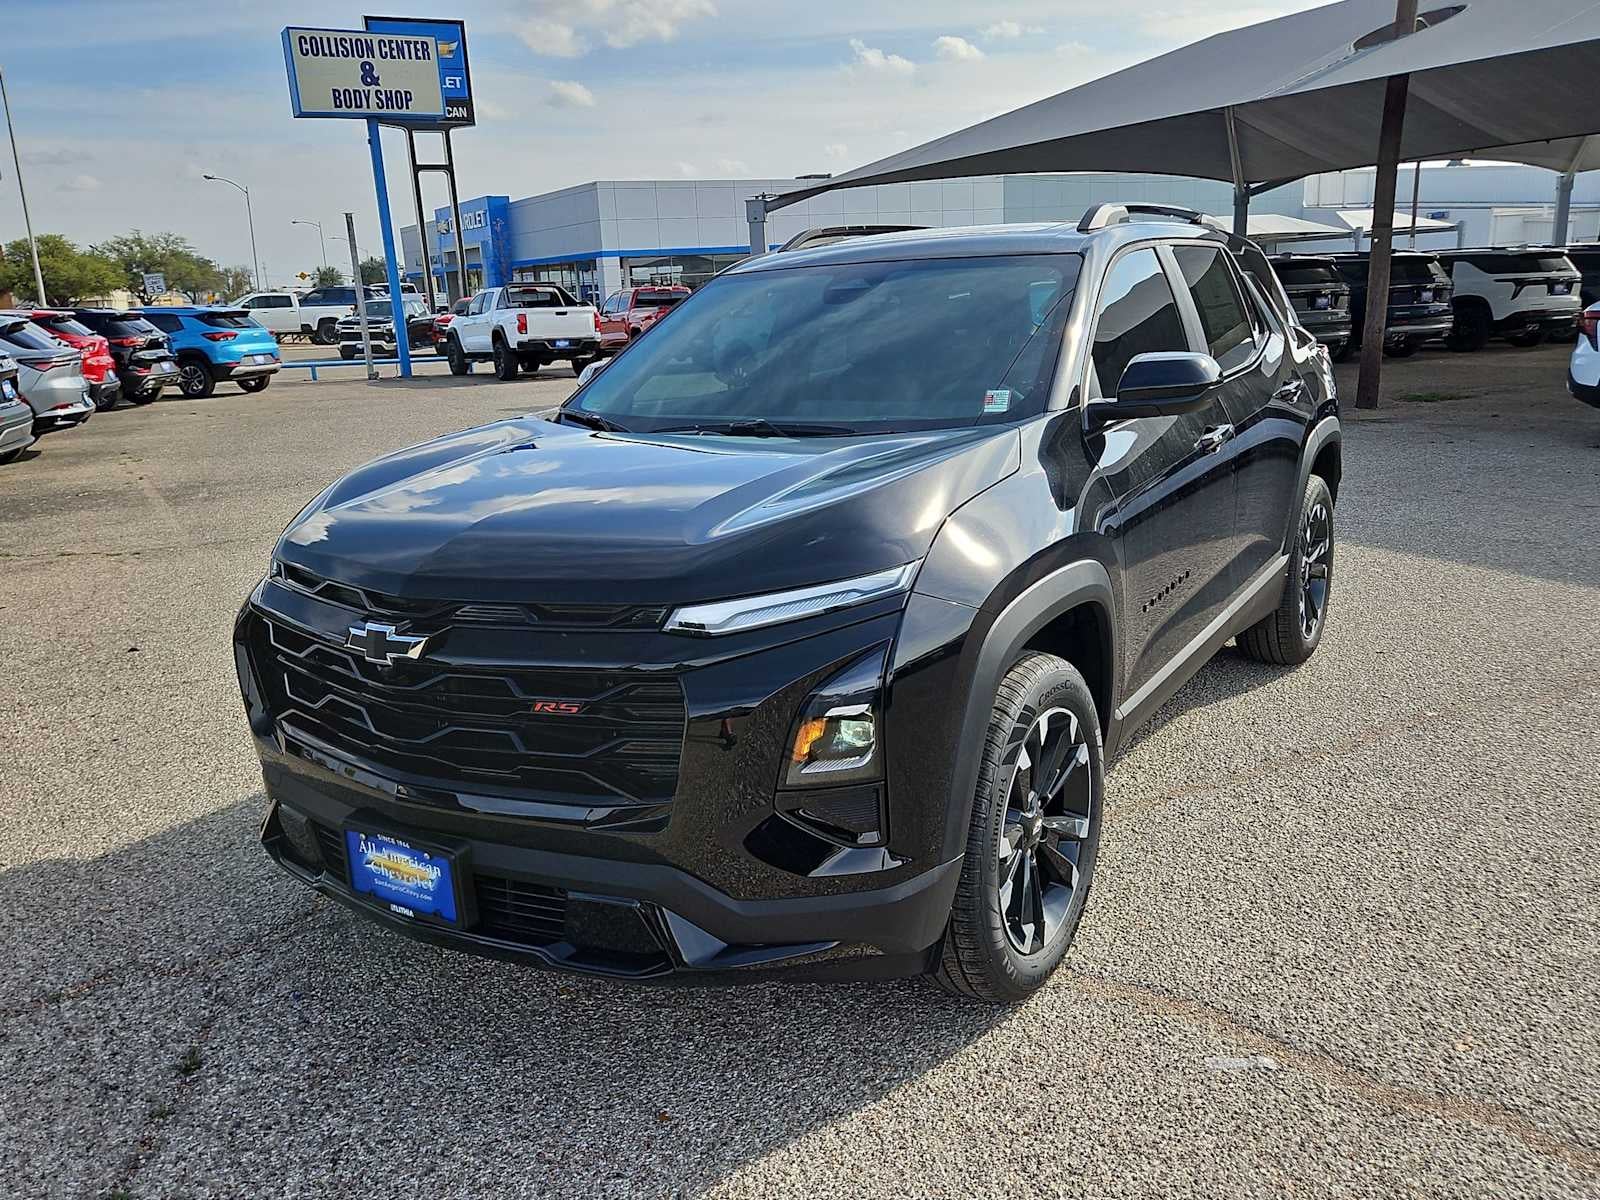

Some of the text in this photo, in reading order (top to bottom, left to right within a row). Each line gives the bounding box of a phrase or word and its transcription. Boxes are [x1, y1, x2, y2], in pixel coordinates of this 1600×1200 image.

[298, 35, 431, 60] COLLISION CENTER
[360, 61, 381, 87] &
[332, 88, 413, 110] BODY SHOP
[149, 285, 163, 293] 35
[533, 701, 581, 714] RS
[359, 841, 442, 878] All American
[371, 860, 433, 892] Chevrolet
